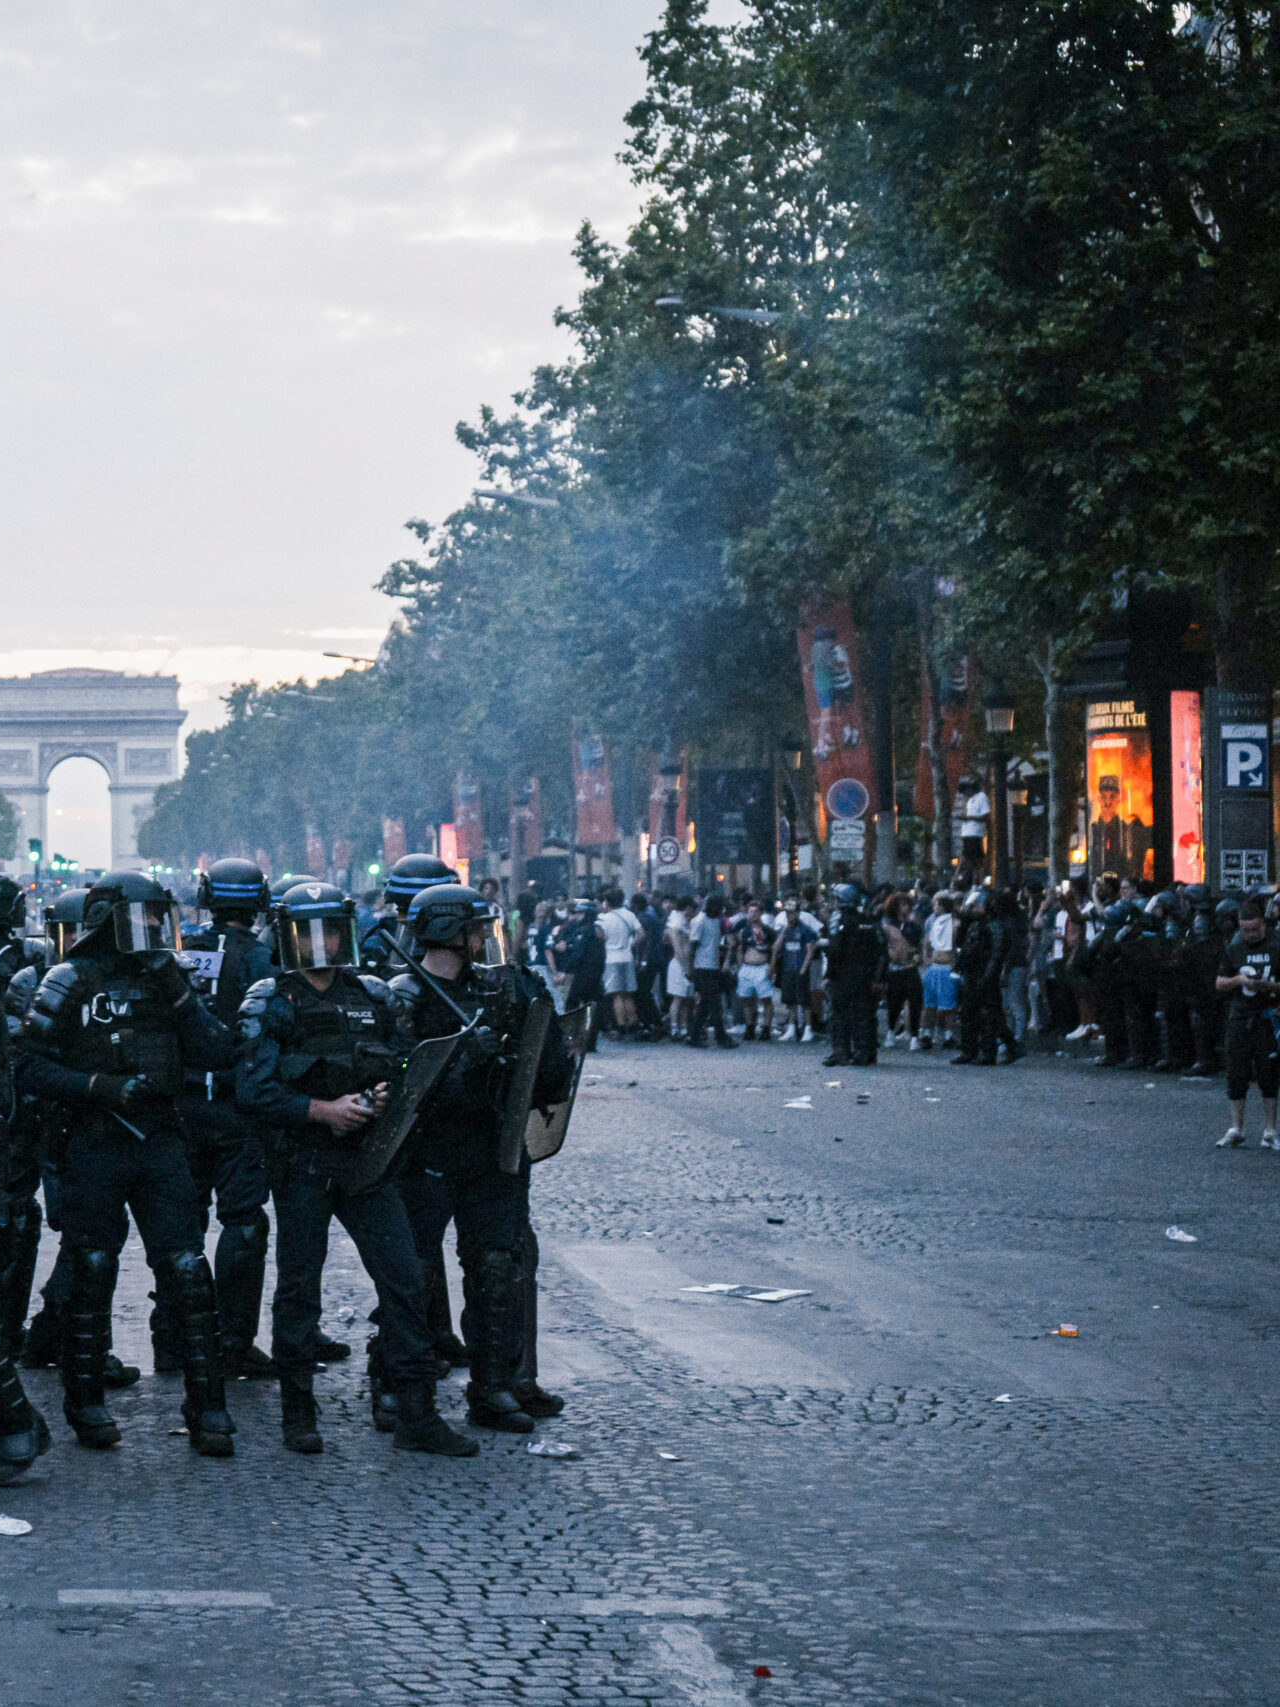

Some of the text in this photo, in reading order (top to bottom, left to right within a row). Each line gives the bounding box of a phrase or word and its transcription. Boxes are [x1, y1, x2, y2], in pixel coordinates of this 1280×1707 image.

[1111, 701, 1135, 714] FILMS
[1226, 742, 1263, 788] P
[662, 846, 676, 857] 50
